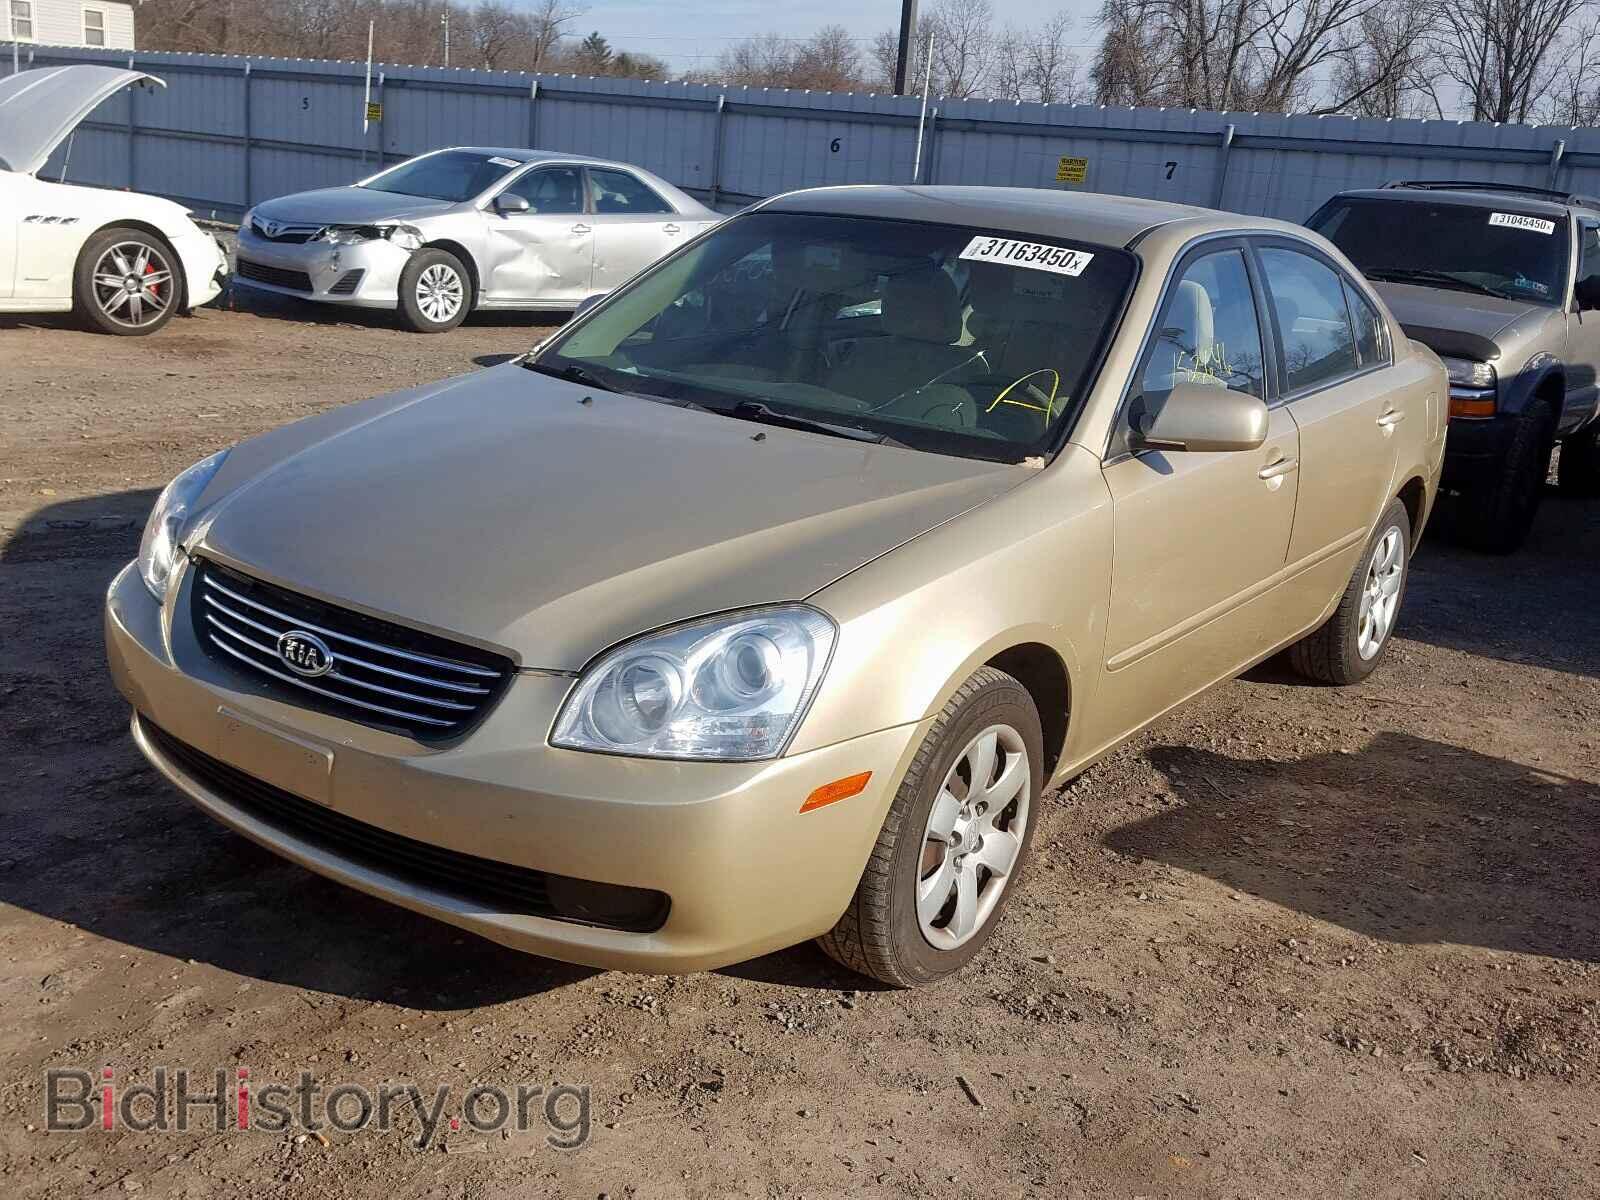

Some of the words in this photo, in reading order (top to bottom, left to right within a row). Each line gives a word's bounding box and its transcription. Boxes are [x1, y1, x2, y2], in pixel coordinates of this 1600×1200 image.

[302, 97, 309, 110] 5
[831, 135, 841, 153] 6
[1165, 161, 1178, 180] 7
[285, 639, 320, 671] KIA
